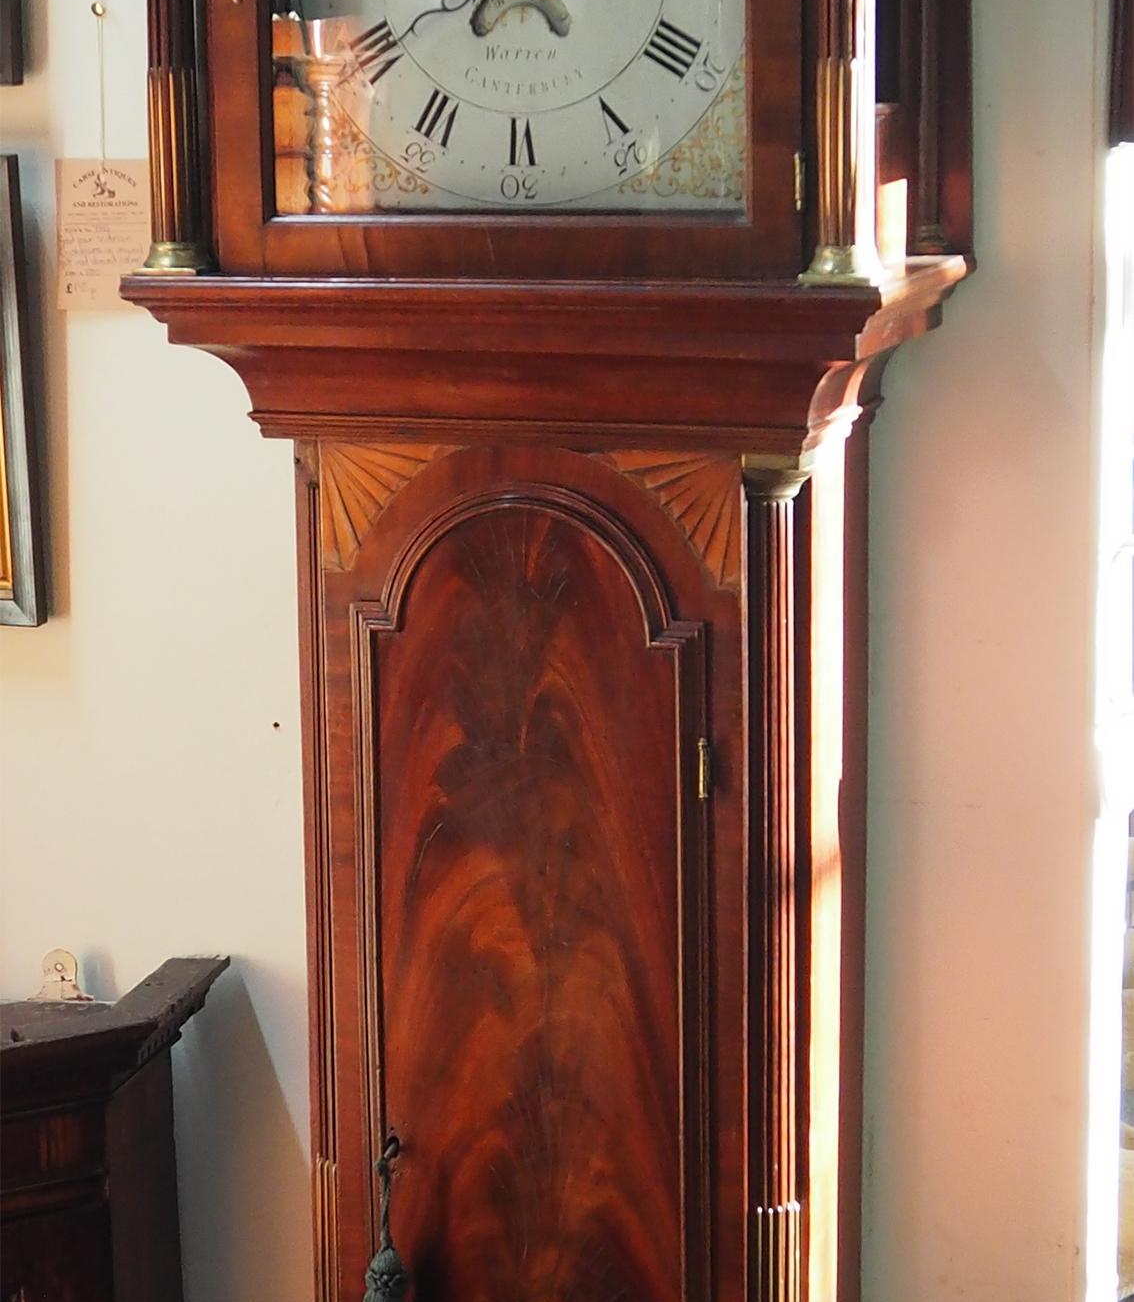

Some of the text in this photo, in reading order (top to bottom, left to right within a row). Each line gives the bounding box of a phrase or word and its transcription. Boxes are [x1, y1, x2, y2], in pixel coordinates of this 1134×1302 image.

[486, 45, 557, 61] Warren
[639, 15, 704, 84] IIII
[695, 50, 726, 93] 20
[411, 87, 461, 149] VII
[598, 95, 633, 146] V
[400, 141, 437, 174] 35
[507, 116, 541, 167] VI
[614, 139, 648, 176] 25
[500, 173, 539, 200] 30
